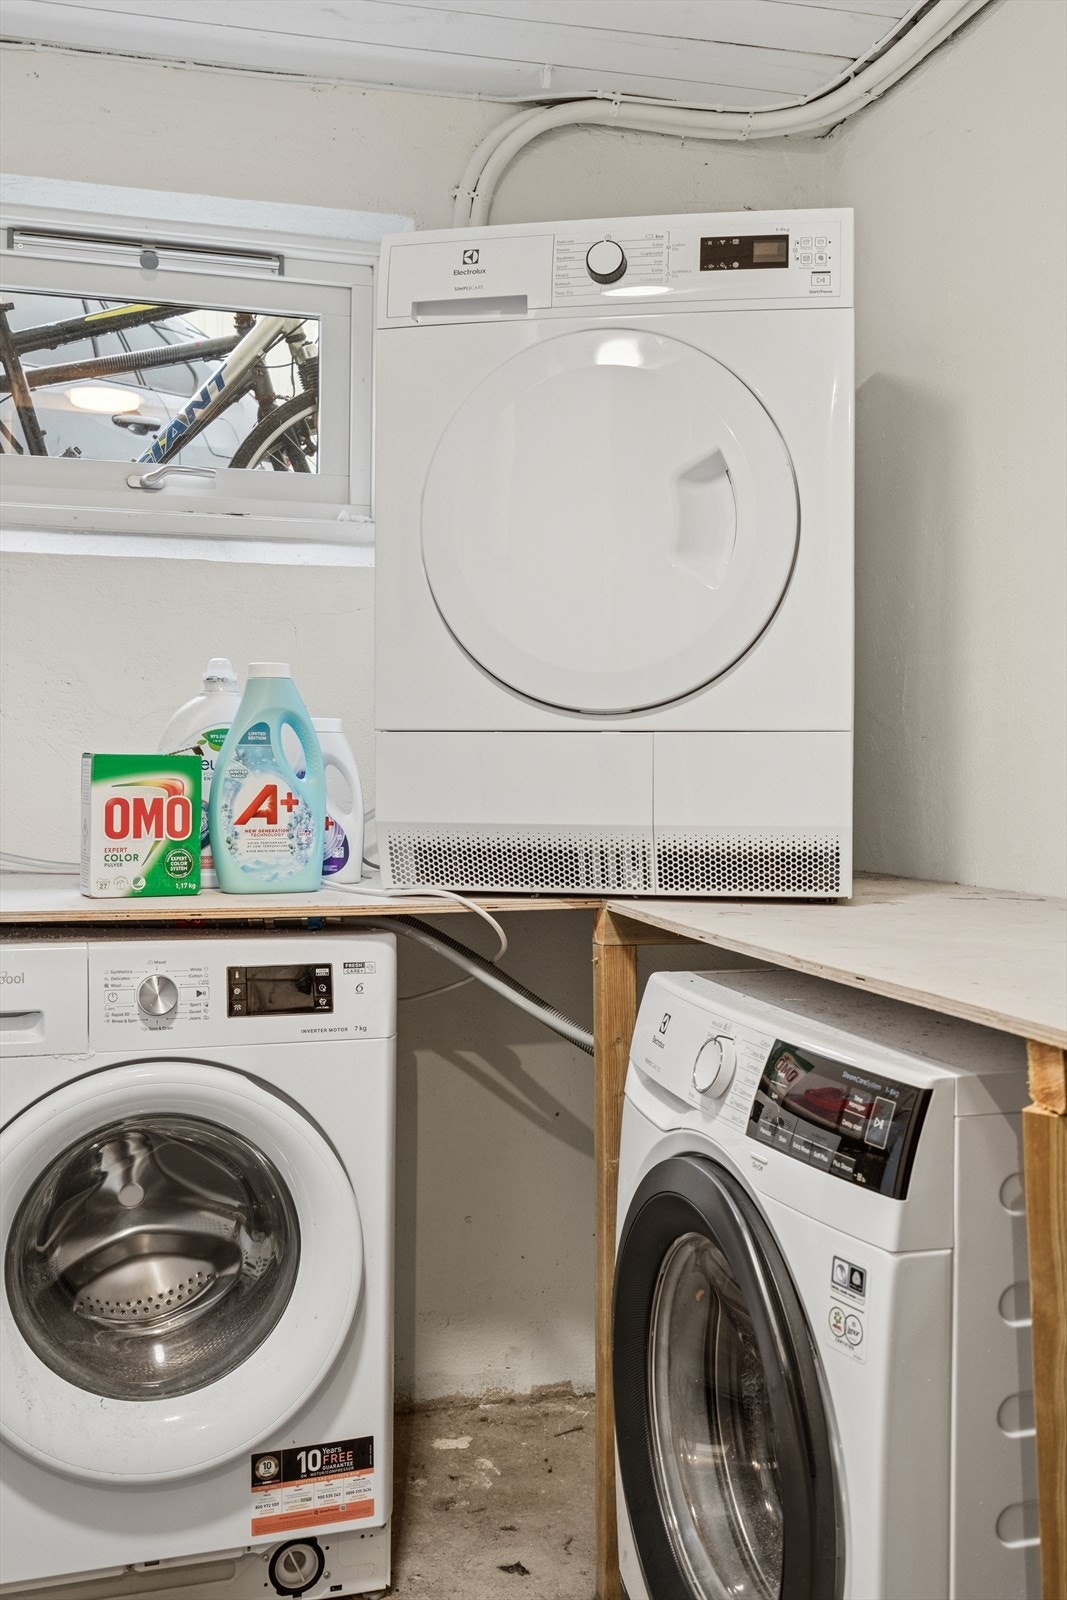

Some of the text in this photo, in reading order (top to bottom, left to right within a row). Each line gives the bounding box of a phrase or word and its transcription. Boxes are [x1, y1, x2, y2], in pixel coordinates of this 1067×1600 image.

[233, 784, 299, 825] A+
[104, 796, 192, 840] OMO
[104, 854, 138, 862] COLOR
[356, 983, 364, 992] 6
[652, 1035, 665, 1049] Electrolux
[848, 1101, 866, 1112] Manager
[842, 1118, 853, 1129] Delay
[322, 1446, 342, 1454] Years
[297, 1449, 321, 1473] 10
[323, 1451, 354, 1465] FREE
[263, 1462, 271, 1470] 10
[322, 1461, 354, 1470] GUARANTEE
